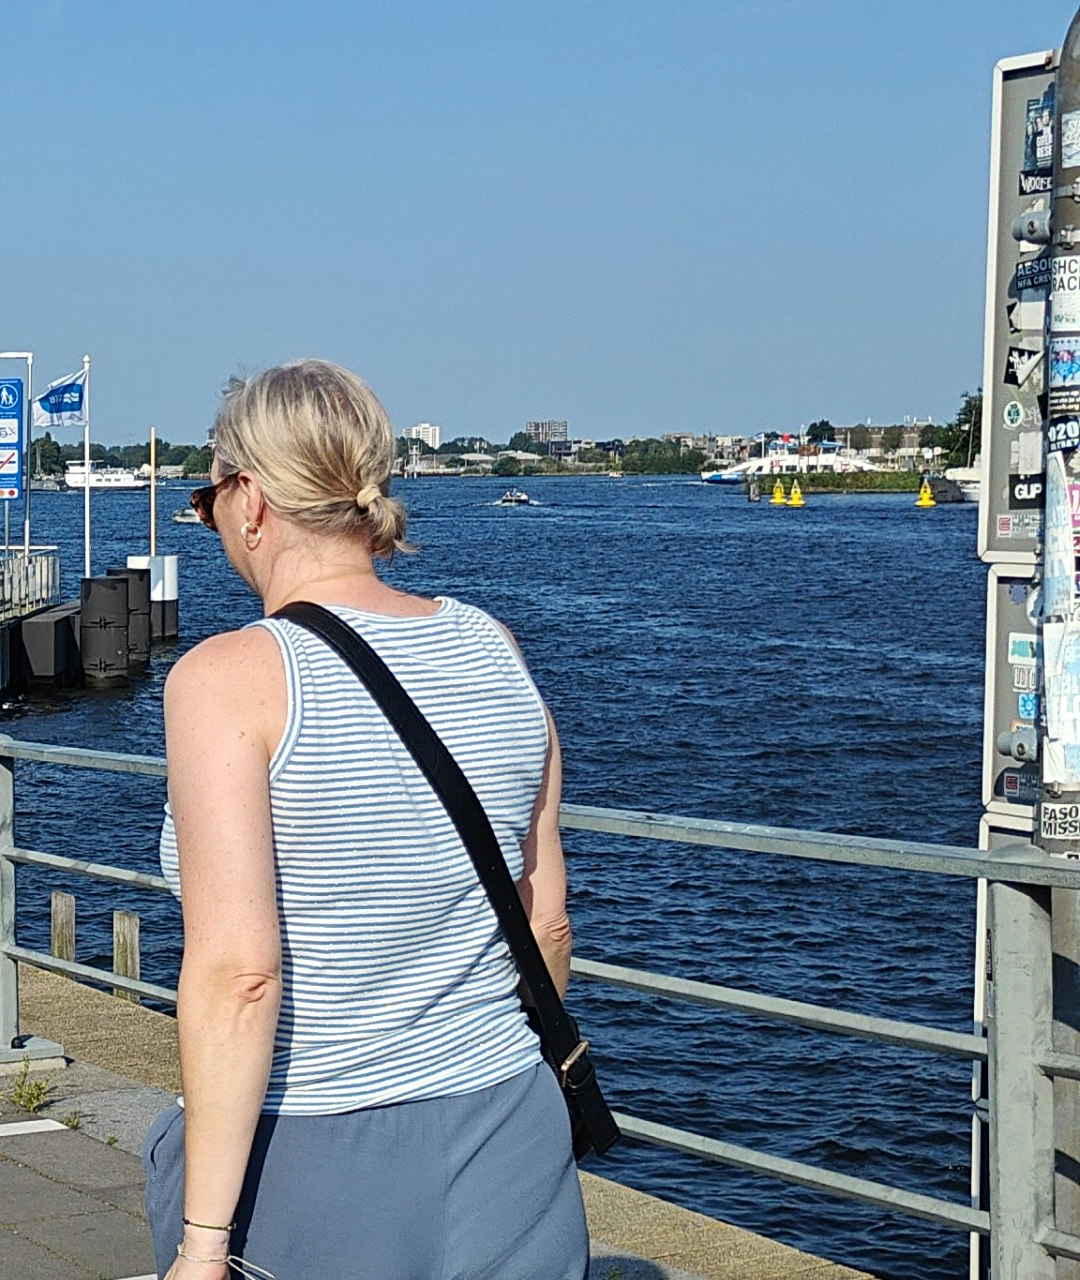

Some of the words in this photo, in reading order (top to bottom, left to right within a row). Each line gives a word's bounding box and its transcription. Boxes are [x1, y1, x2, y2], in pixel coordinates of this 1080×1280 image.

[1052, 259, 1080, 275] SHC
[1053, 276, 1080, 292] RAC
[1014, 483, 1042, 500] GUP
[1042, 820, 1080, 836] MISS
